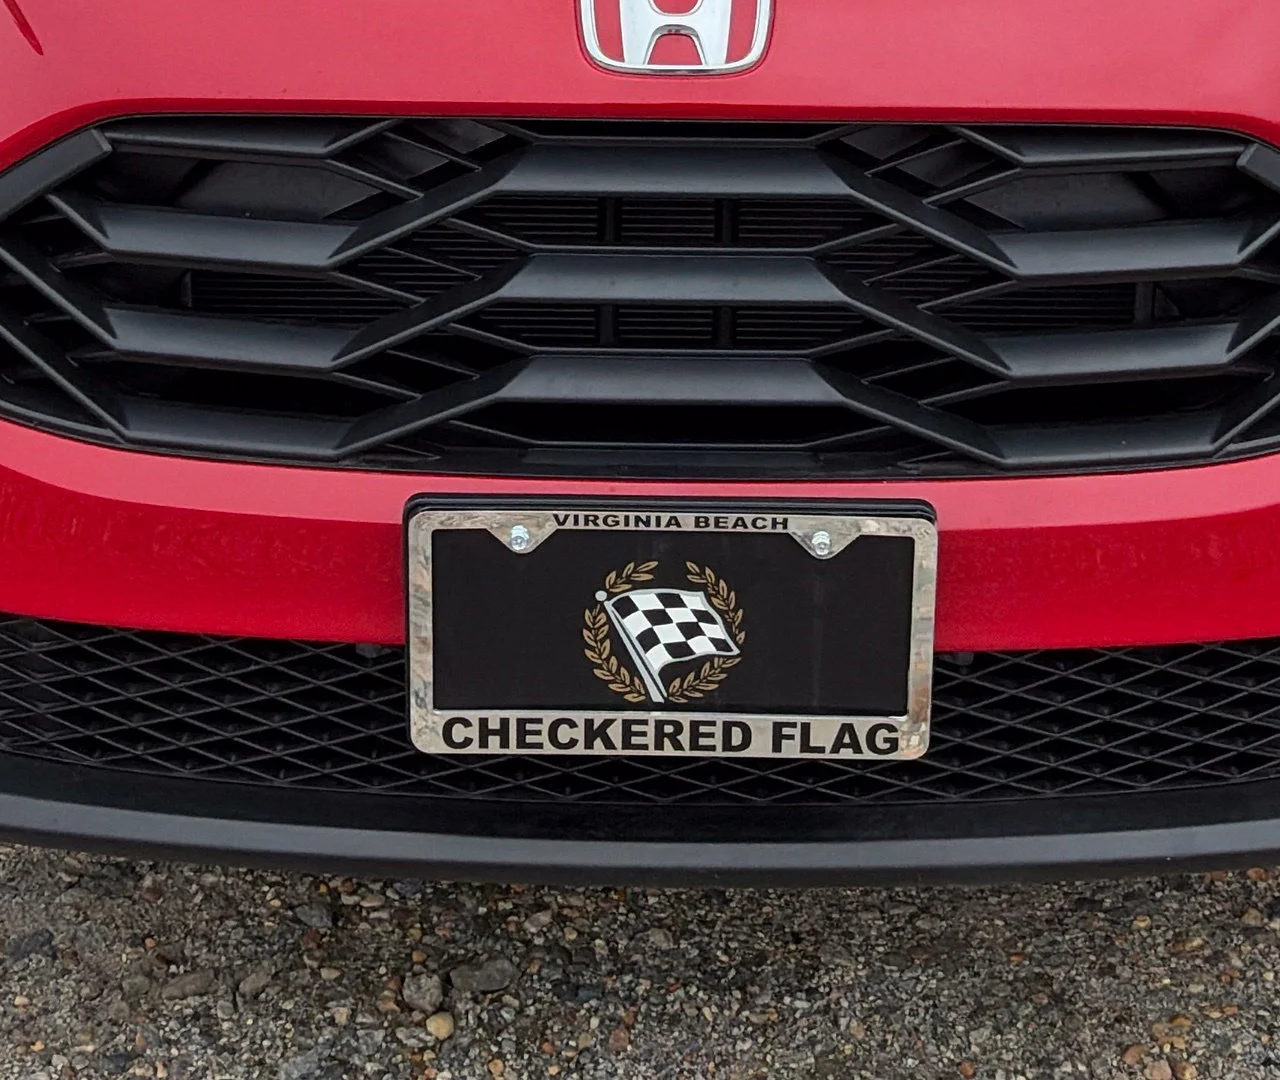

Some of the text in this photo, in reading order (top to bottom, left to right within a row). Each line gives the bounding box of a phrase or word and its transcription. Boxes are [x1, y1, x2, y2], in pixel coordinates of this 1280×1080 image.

[552, 512, 790, 532] VIRGINIA BEACH
[441, 716, 901, 756] CHECKERED FLAG
